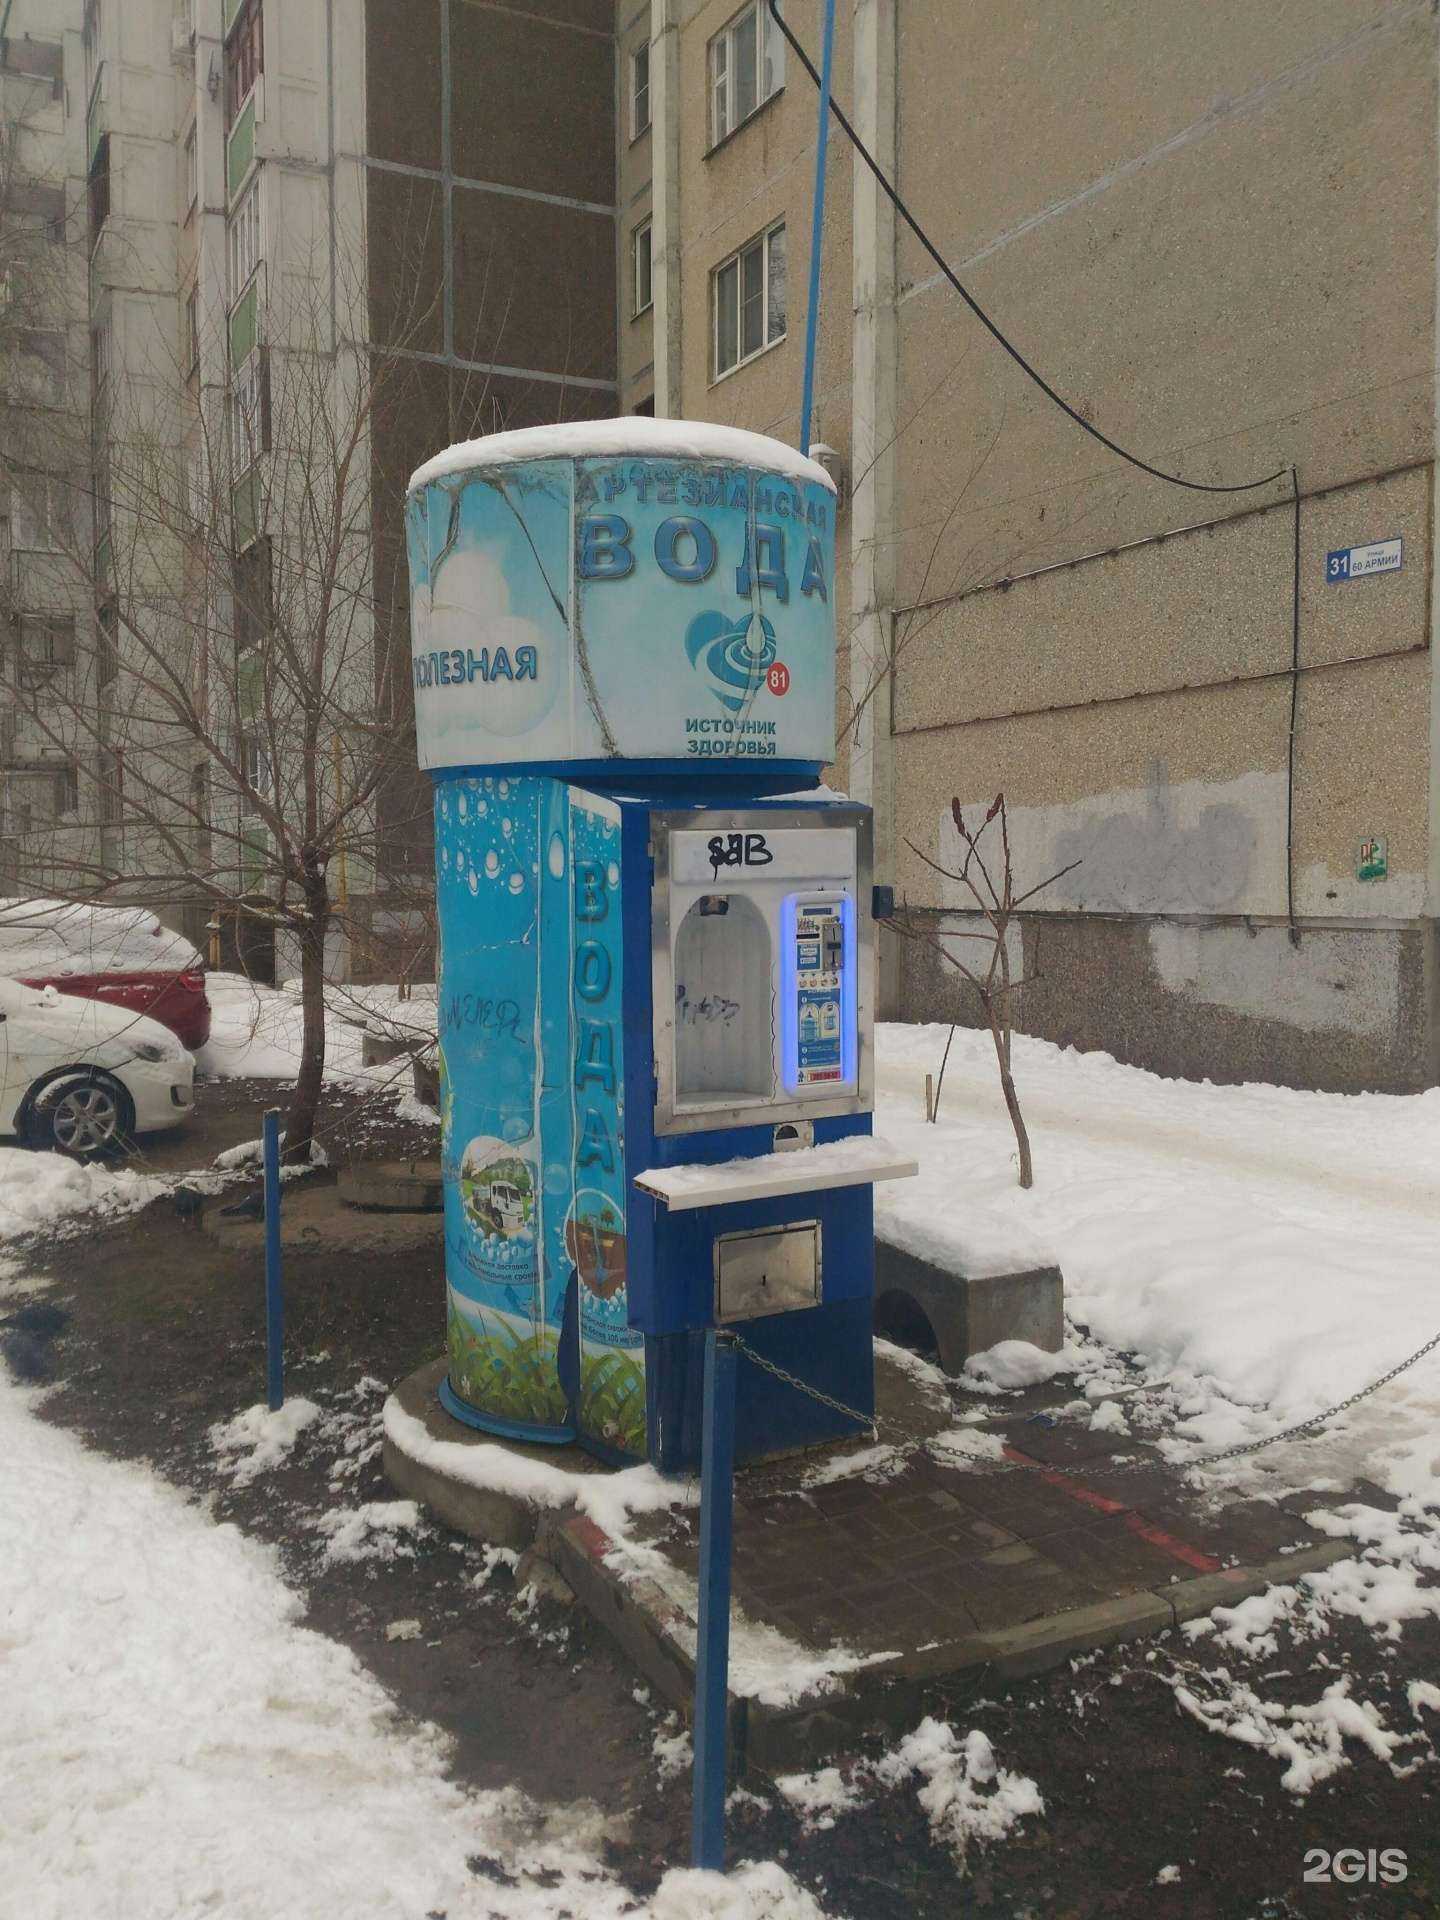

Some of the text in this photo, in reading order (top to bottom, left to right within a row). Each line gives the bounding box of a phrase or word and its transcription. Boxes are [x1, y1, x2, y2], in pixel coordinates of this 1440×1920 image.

[579, 513, 829, 604] ВОДА
[1330, 556, 1349, 576] 31
[1352, 553, 1399, 572] 60 АРМИИ
[771, 670, 786, 688] 81
[685, 718, 776, 734] ИСТОЧНИК
[687, 739, 776, 756] ЗДОРОВЬЯ
[575, 860, 617, 1174] ВОДА
